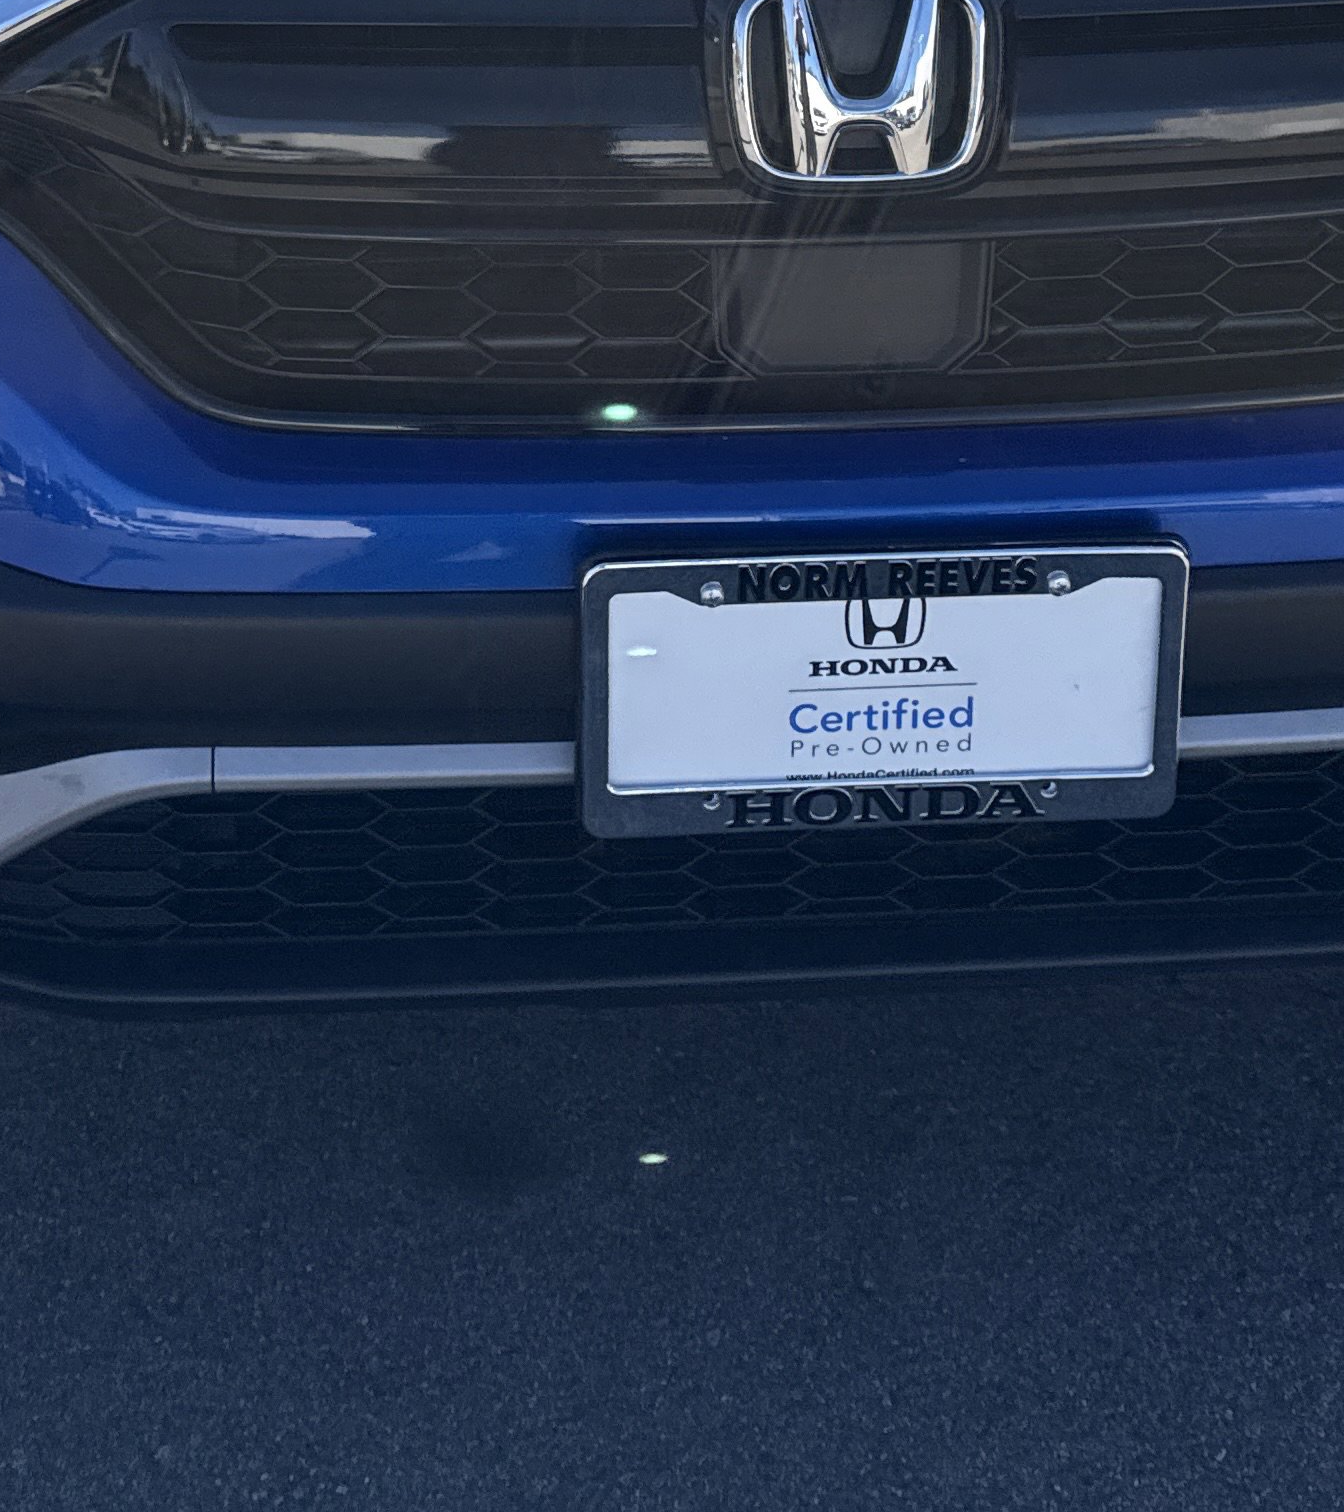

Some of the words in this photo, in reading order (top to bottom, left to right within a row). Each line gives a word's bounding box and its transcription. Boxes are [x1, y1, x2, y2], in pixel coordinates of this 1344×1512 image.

[737, 560, 868, 602] NORM
[887, 556, 1038, 596] REEVES
[808, 656, 958, 677] HONDA
[789, 696, 974, 734] Certified
[790, 733, 973, 758] Pre-Owned
[786, 767, 975, 782] wwwHondaCertifiedcom
[724, 781, 1046, 828] HONDA
